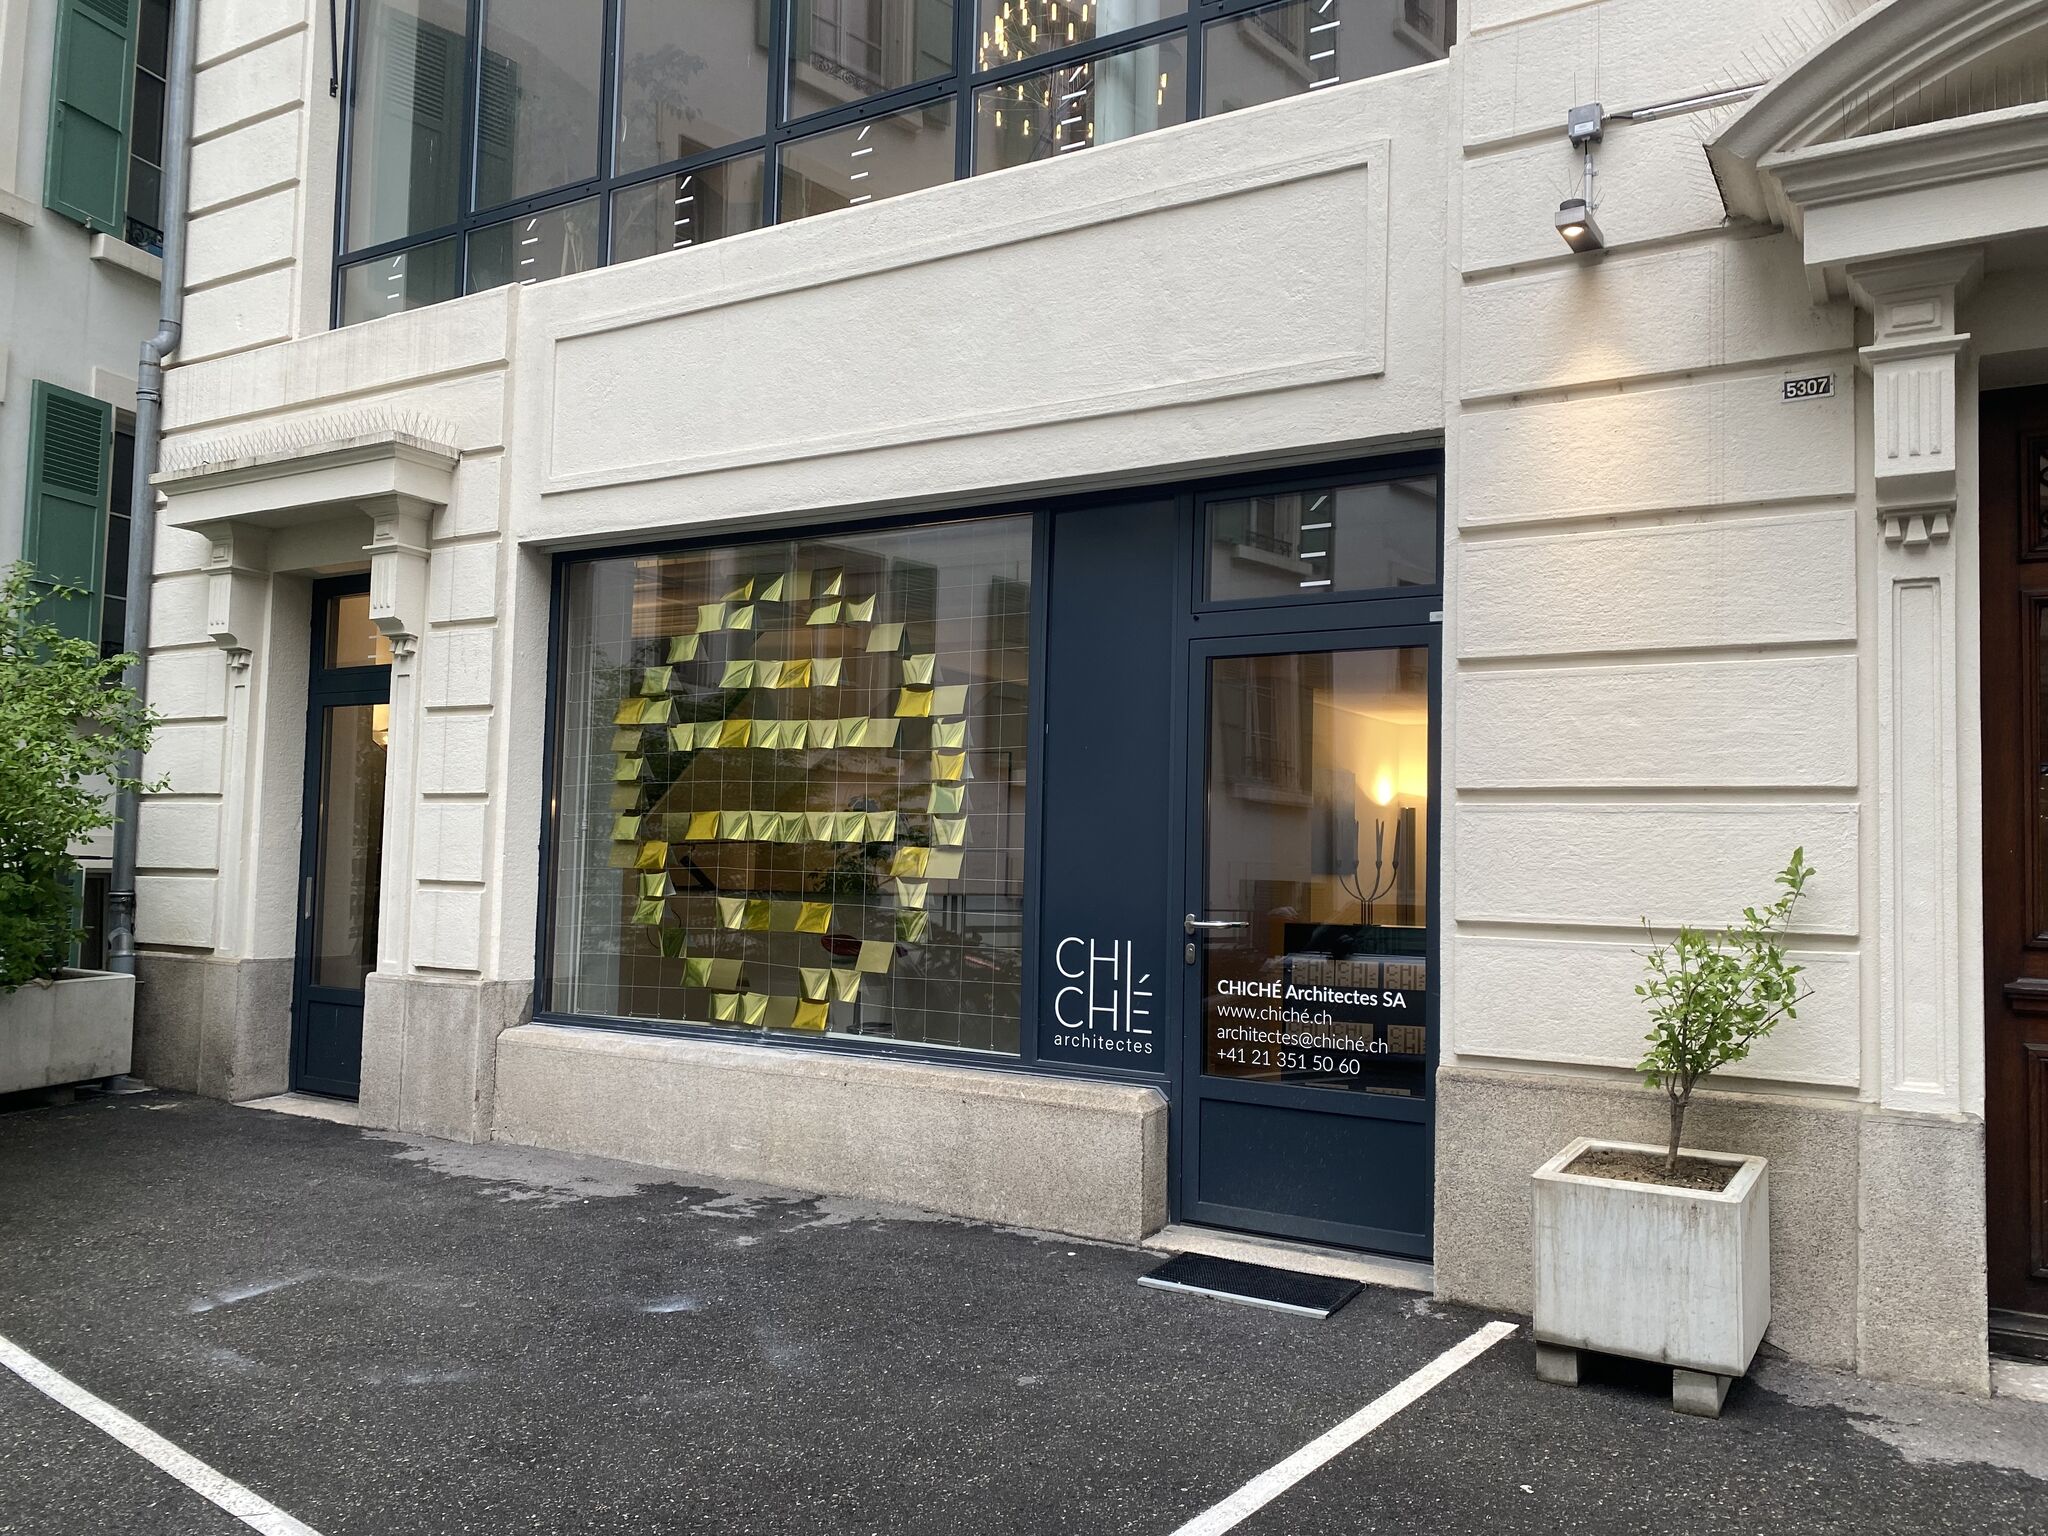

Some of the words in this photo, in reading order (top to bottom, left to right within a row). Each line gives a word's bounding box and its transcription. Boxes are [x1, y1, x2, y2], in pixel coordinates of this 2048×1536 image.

[1786, 378, 1828, 398] 5307
[1217, 979, 1282, 999] CHICHÉ
[1285, 985, 1378, 1007] Architectes
[1382, 991, 1407, 1009] SA
[1217, 1005, 1332, 1026] www.chiché.ch
[1053, 1032, 1153, 1054] architectes
[1217, 1025, 1388, 1054] architectes@chiché.ch
[1217, 1047, 1246, 1064] +41
[1251, 1049, 1271, 1066] 21
[1276, 1051, 1307, 1070] 351
[1312, 1055, 1334, 1072] 50
[1338, 1058, 1361, 1075] 60
